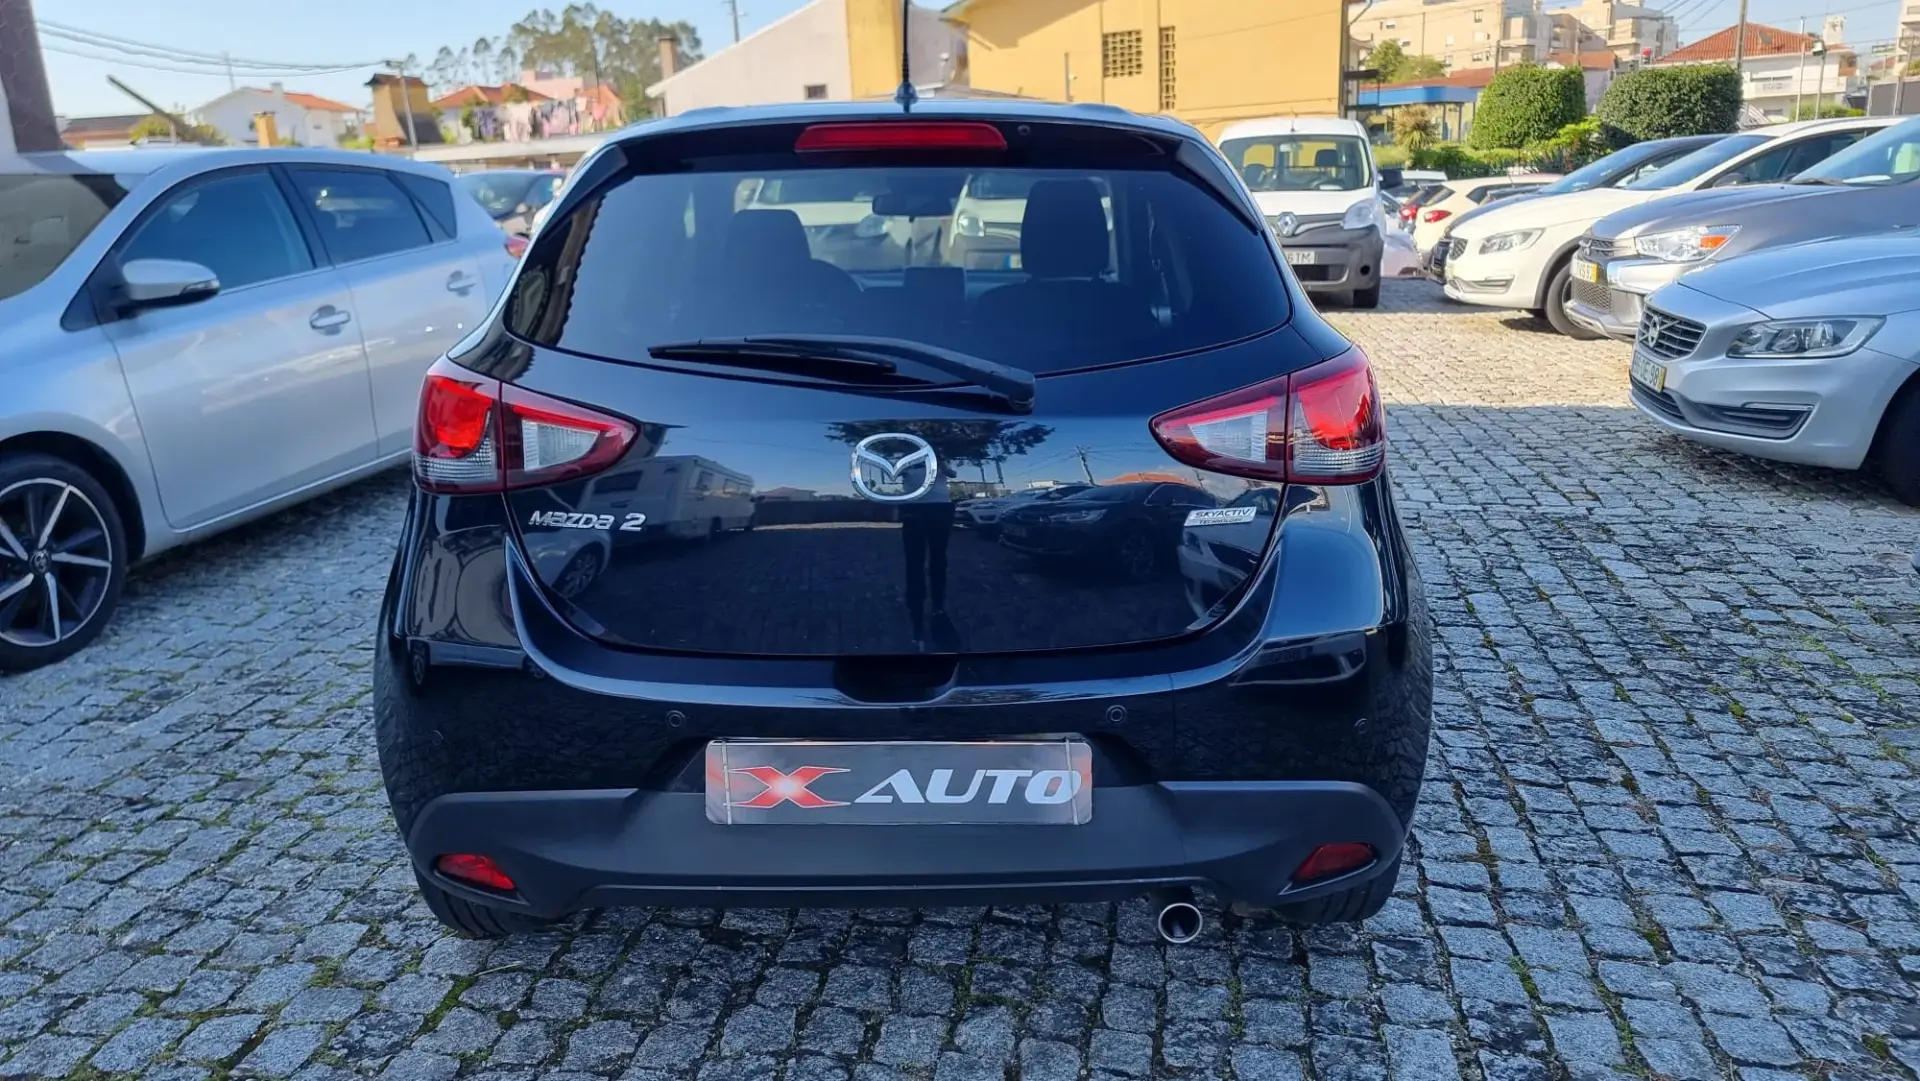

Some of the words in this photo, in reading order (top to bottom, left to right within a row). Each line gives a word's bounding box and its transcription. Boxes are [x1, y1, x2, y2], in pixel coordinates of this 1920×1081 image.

[619, 512, 646, 532] 2
[1195, 508, 1251, 518] SKYACTIV
[723, 766, 851, 808] X
[853, 769, 1083, 805] AUTO
